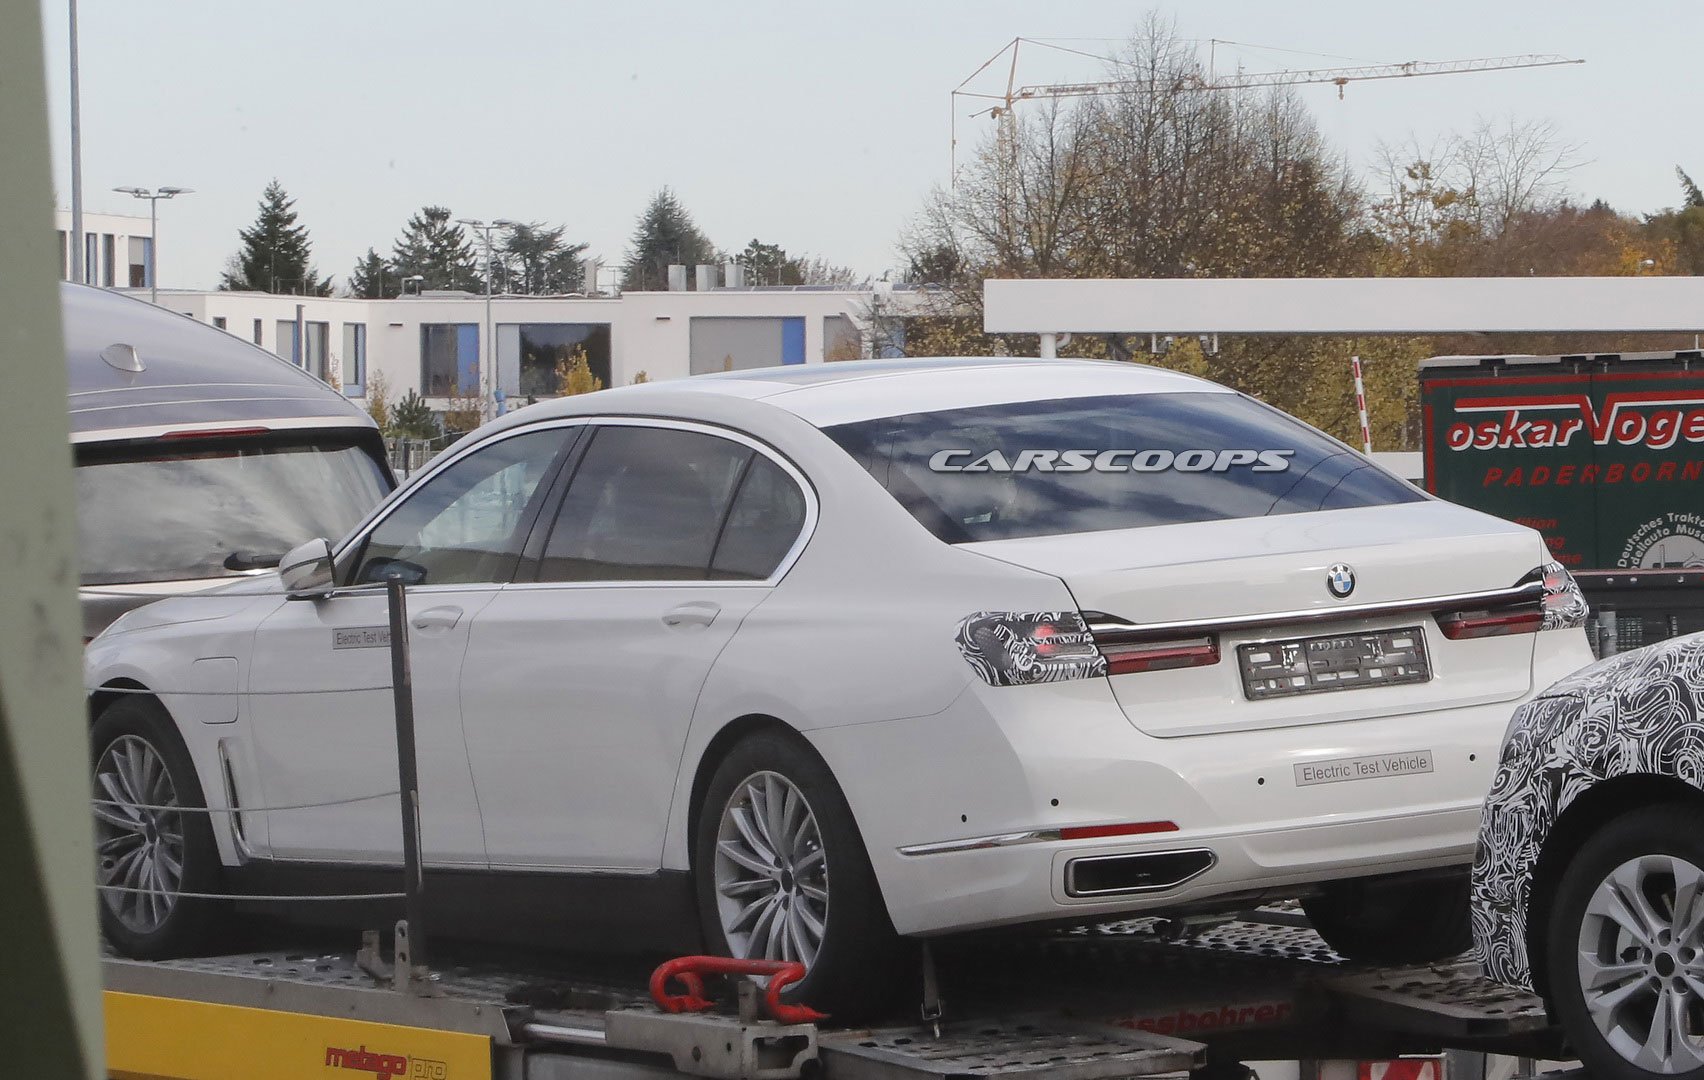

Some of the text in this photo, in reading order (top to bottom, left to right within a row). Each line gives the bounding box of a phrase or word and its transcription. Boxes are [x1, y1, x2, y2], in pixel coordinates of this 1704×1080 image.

[1446, 410, 1583, 450] oskar
[1483, 461, 1704, 486] PADERBORN
[1617, 517, 1663, 568] Deutsches
[363, 631, 377, 643] Test
[1303, 756, 1427, 781] Electric Test Vehicle
[1106, 1001, 1291, 1034] ssbohrer
